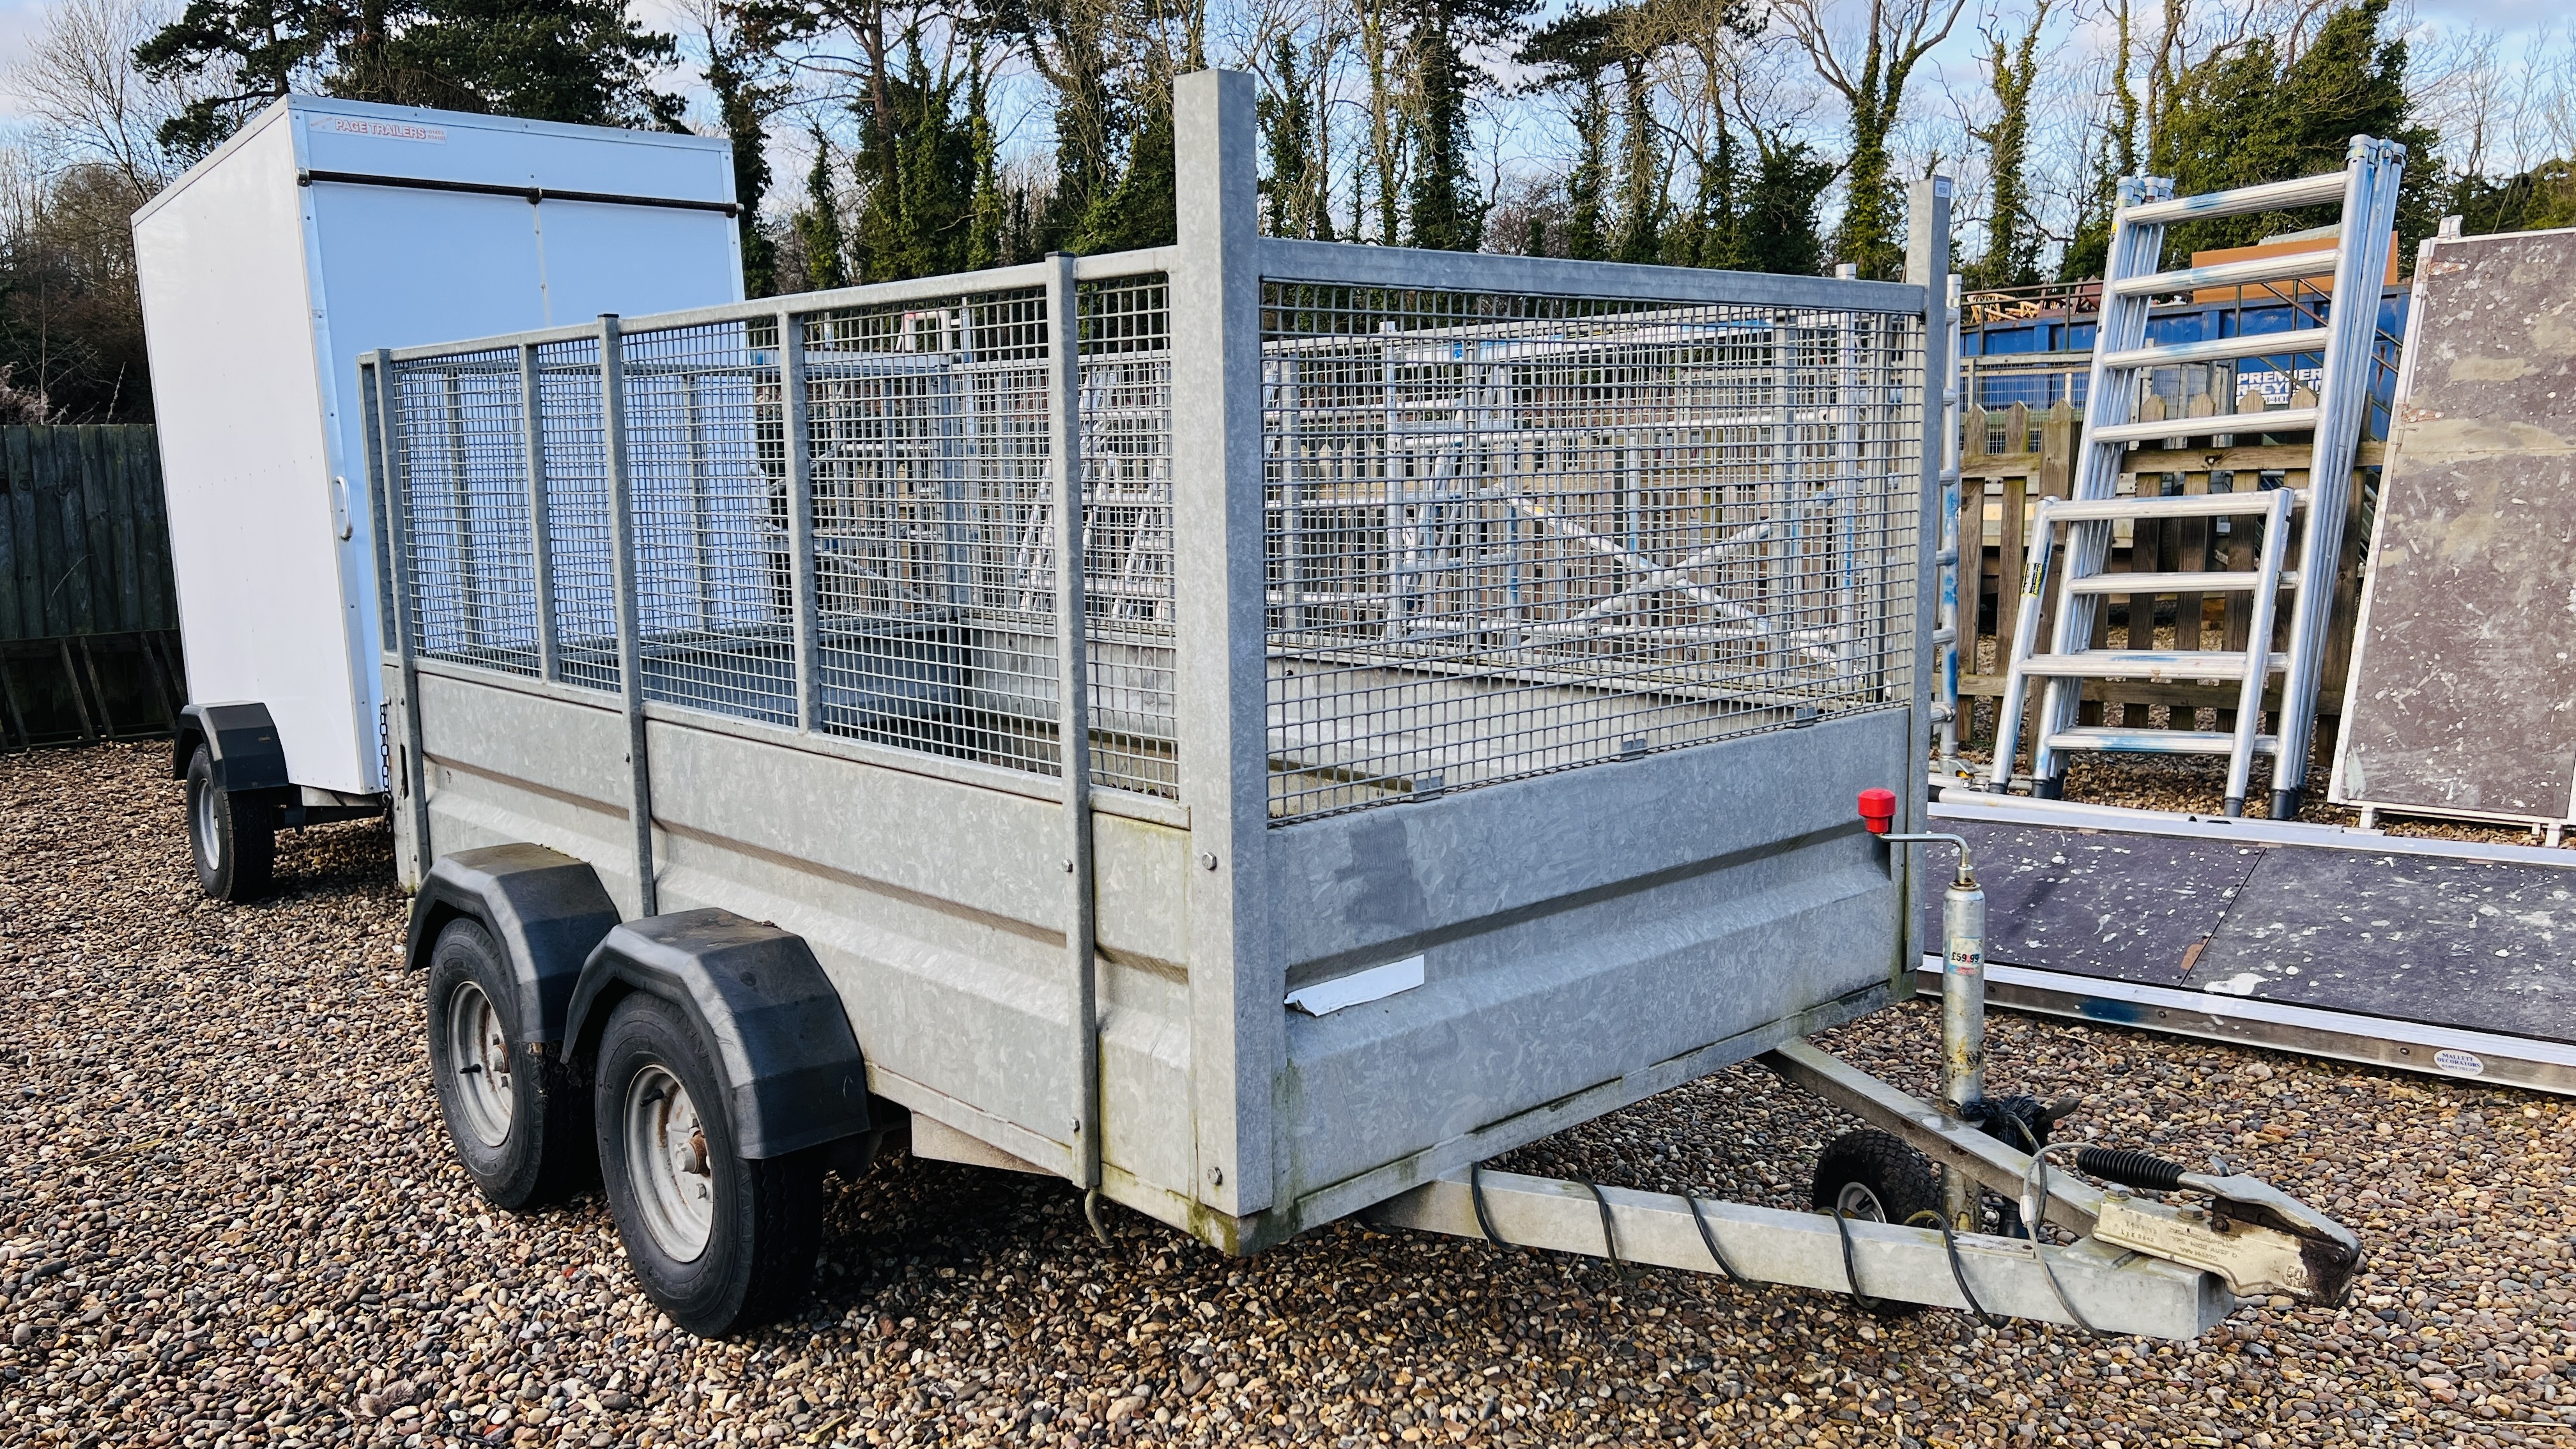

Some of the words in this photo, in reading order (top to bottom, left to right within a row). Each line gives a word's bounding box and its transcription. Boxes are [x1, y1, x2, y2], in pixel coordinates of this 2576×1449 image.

[334, 119, 368, 133] PAGE
[369, 123, 427, 139] TRAILERS
[2237, 368, 2323, 385] PREMIER
[1951, 952, 1979, 963] £59.99
[2437, 1057, 2481, 1068] DECORATORS
[2442, 1053, 2474, 1062] MALLETT
[2286, 1265, 2303, 1280] 50
